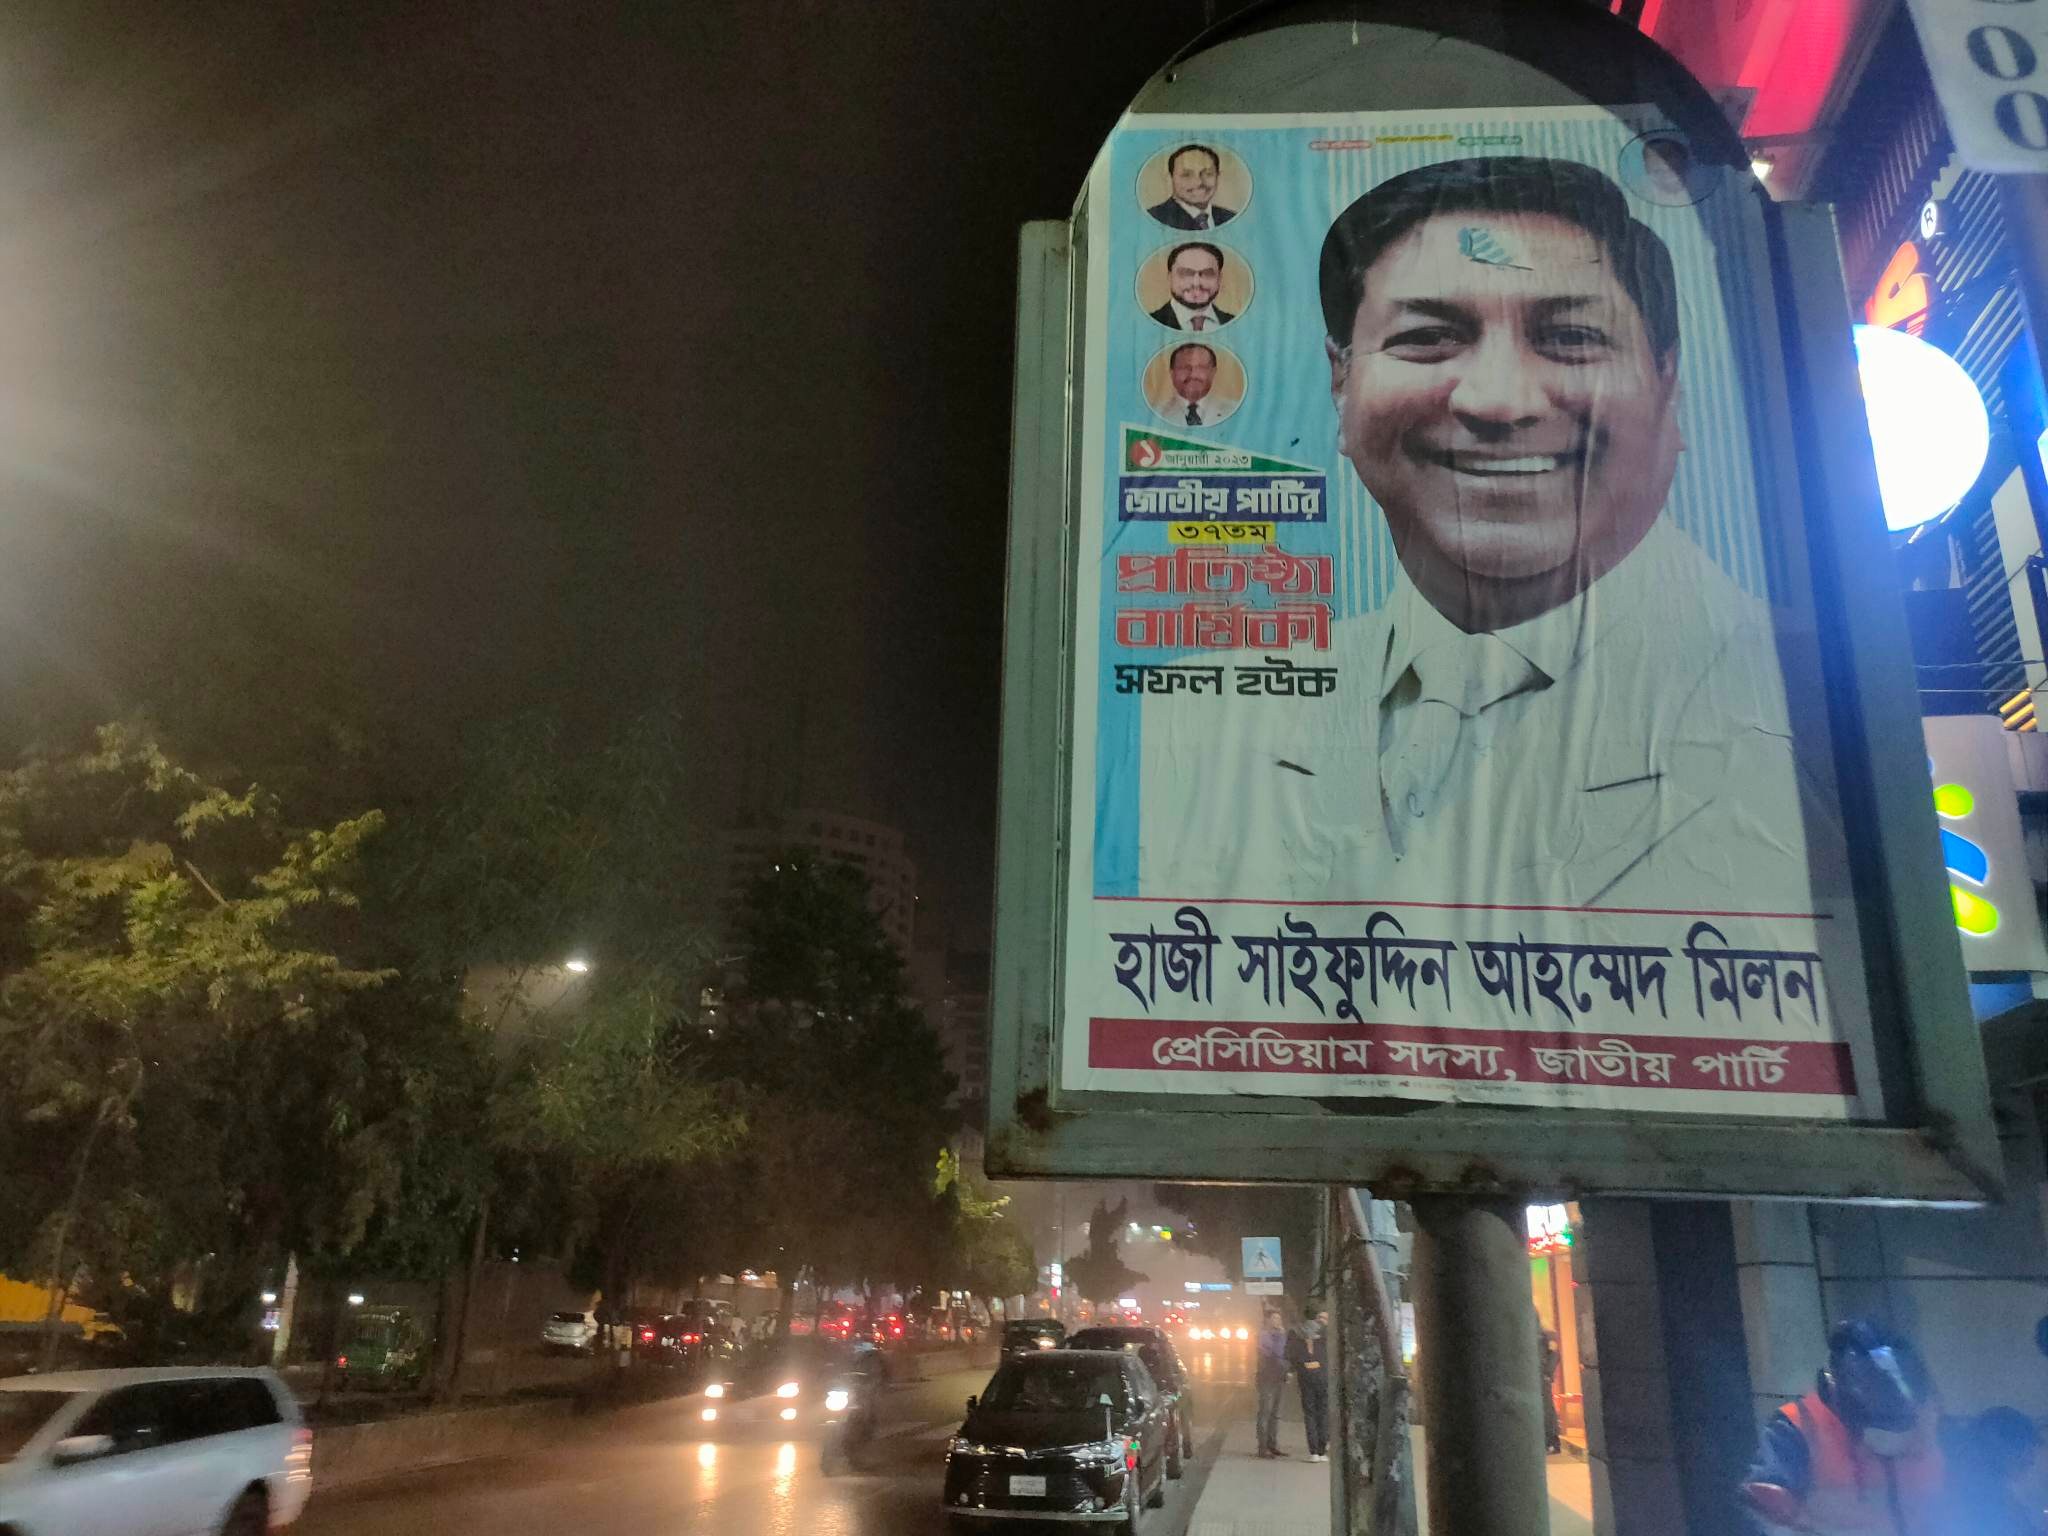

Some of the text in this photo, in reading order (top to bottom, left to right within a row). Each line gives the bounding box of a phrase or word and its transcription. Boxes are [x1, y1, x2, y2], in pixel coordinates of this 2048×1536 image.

[1214, 454, 1249, 466] ২০২৩
[1124, 479, 1321, 521] জাতীয় পার্টির
[1176, 522, 1269, 541] ৩৭তম
[1117, 544, 1334, 595] প্রতিষ্ঠা
[1115, 601, 1335, 651] বার্ষিকী
[1114, 656, 1338, 697] সফল হউক
[1108, 905, 1822, 1026] হাজী সাইফুদ্দিন আহম্মেদ মিলন
[1152, 1027, 1790, 1087] প্রেসিডিয়াম সদস্য, জাতীয় পার্টি
